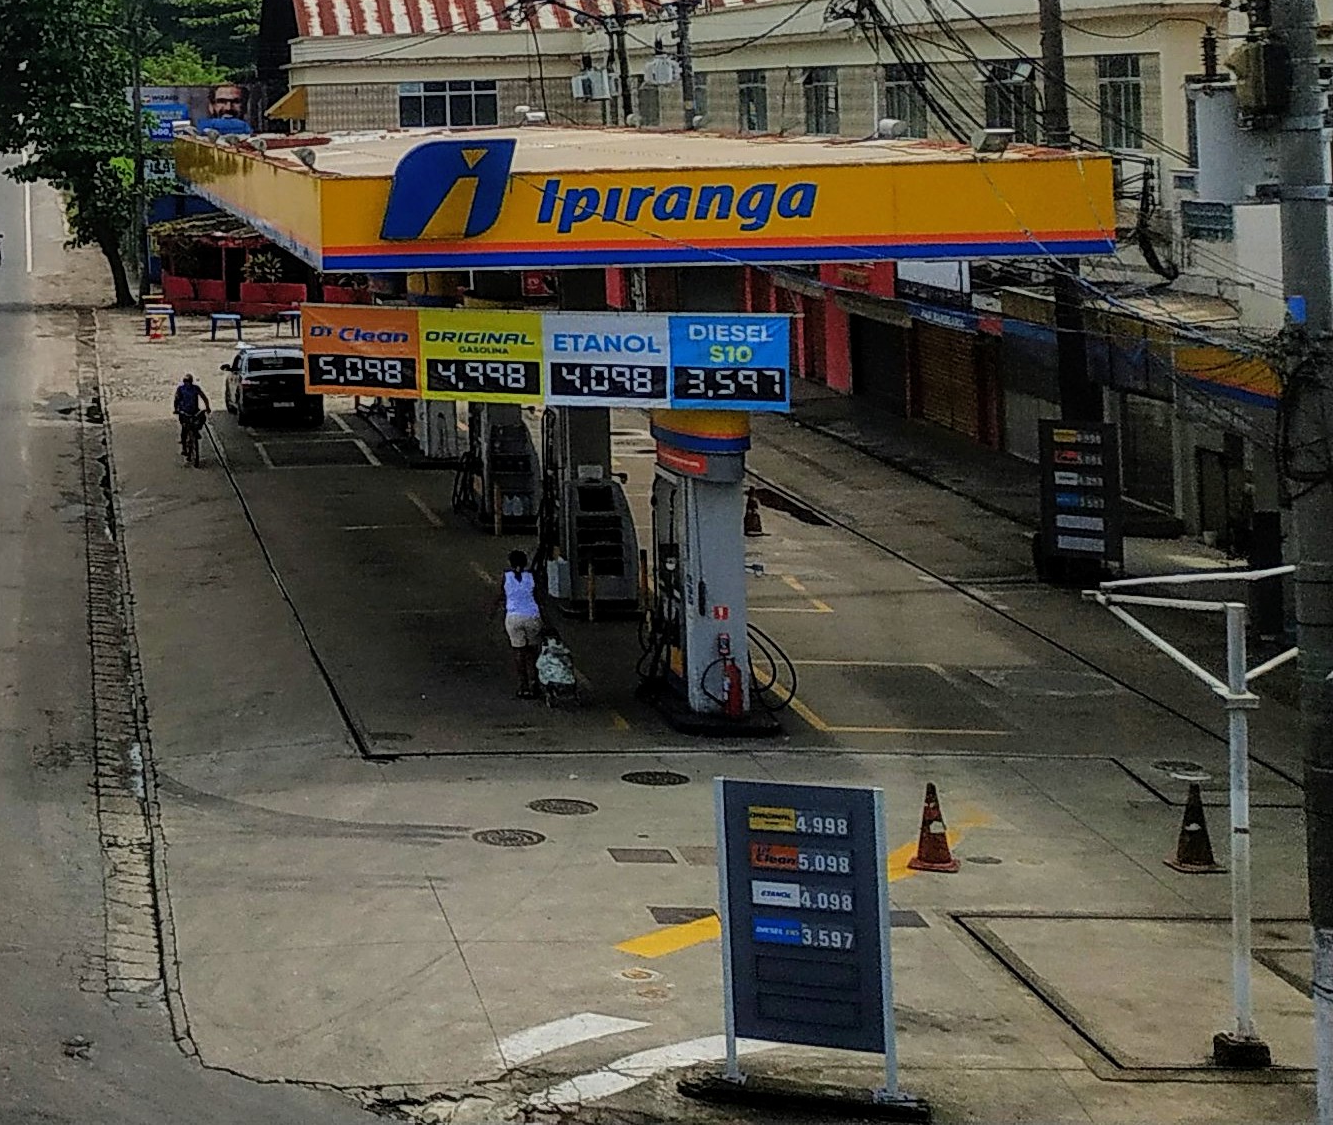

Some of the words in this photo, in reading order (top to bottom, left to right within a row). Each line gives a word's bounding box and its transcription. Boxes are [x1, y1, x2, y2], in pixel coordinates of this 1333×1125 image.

[537, 179, 818, 233] Ipiranga
[338, 327, 409, 344] Clean
[425, 330, 535, 345] ORIGINAL
[689, 324, 774, 342] DIESEL
[458, 346, 509, 355] GASOLINA
[553, 333, 661, 353] ETANOL
[709, 345, 753, 363] S10
